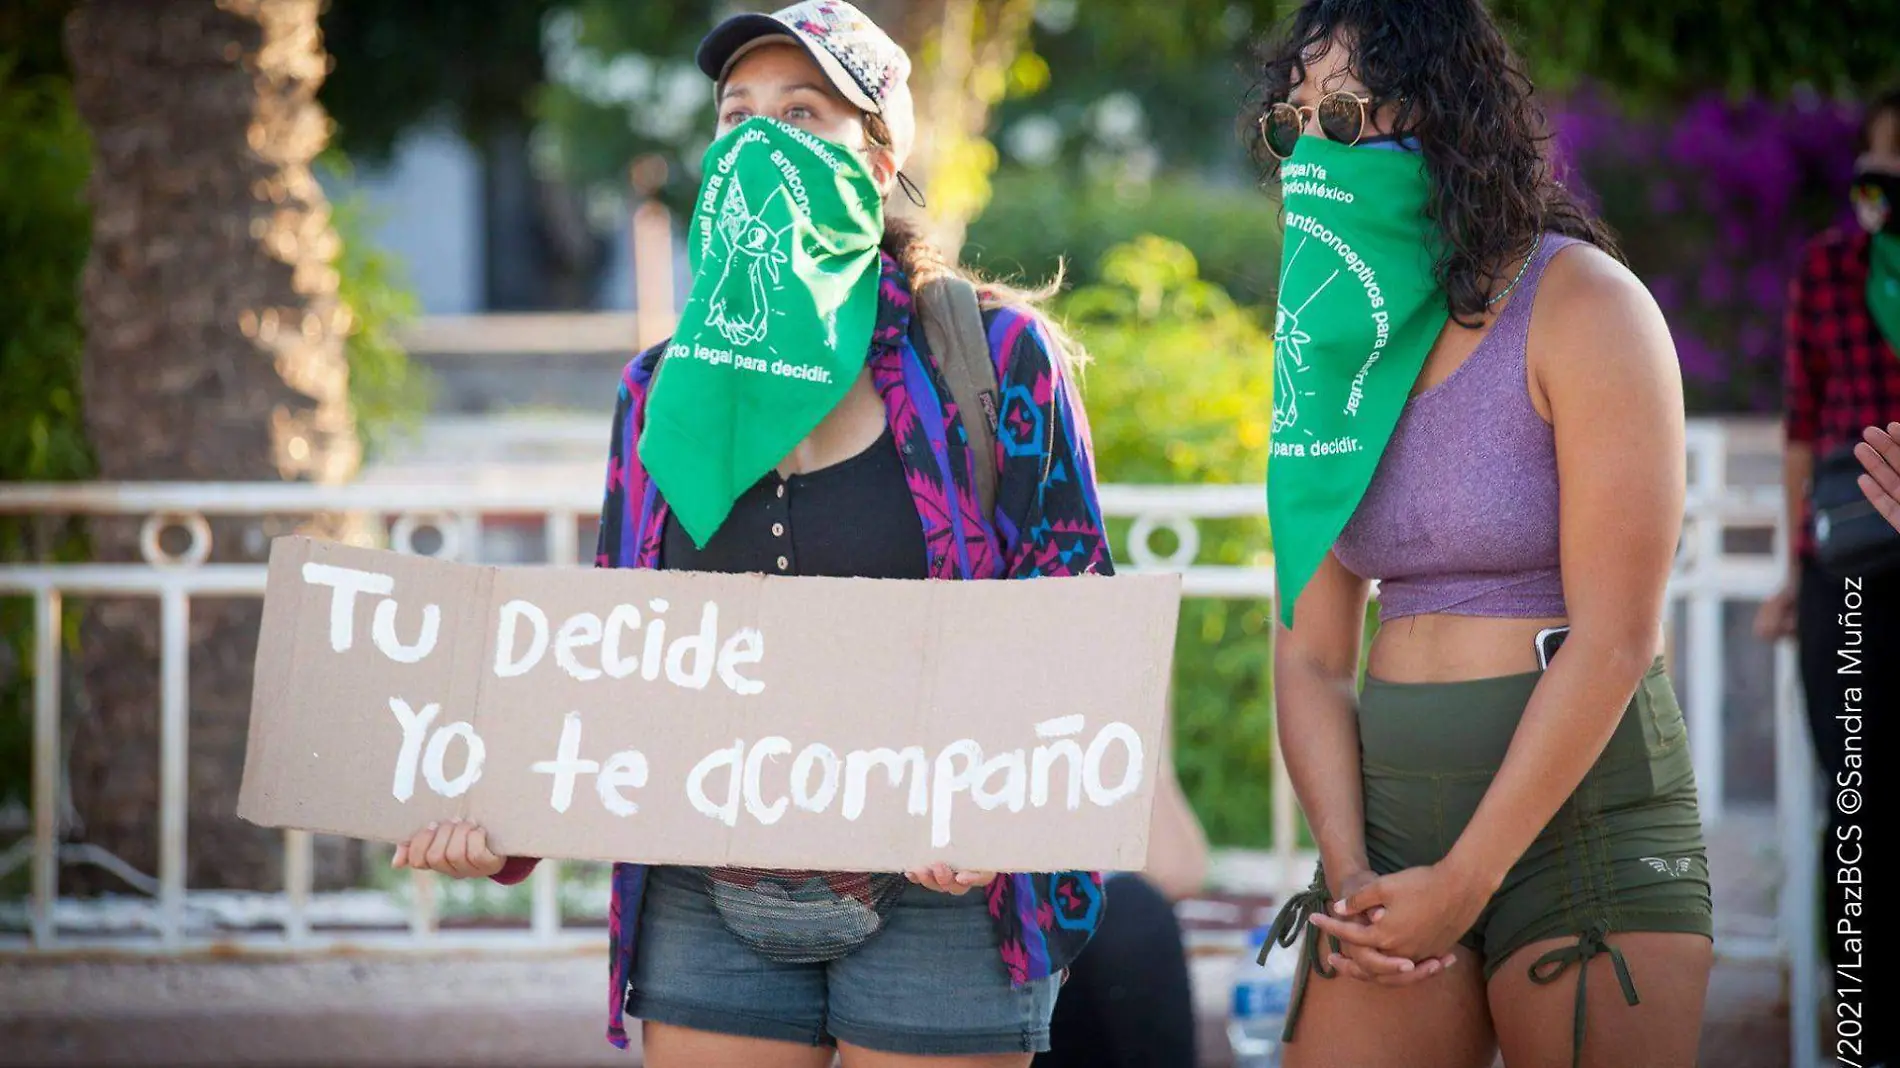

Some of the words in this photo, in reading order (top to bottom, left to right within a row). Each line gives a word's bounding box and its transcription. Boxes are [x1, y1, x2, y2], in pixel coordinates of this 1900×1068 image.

[702, 174, 724, 214] para
[1286, 211, 1385, 309] anticonceptivos
[1371, 310, 1390, 349] para
[693, 343, 733, 365] legal
[734, 353, 768, 374] para
[770, 359, 834, 384] decidir.
[1273, 440, 1306, 458] para
[1309, 434, 1364, 457] decidir.
[532, 710, 649, 818] te
[686, 713, 1145, 848] acompaño
